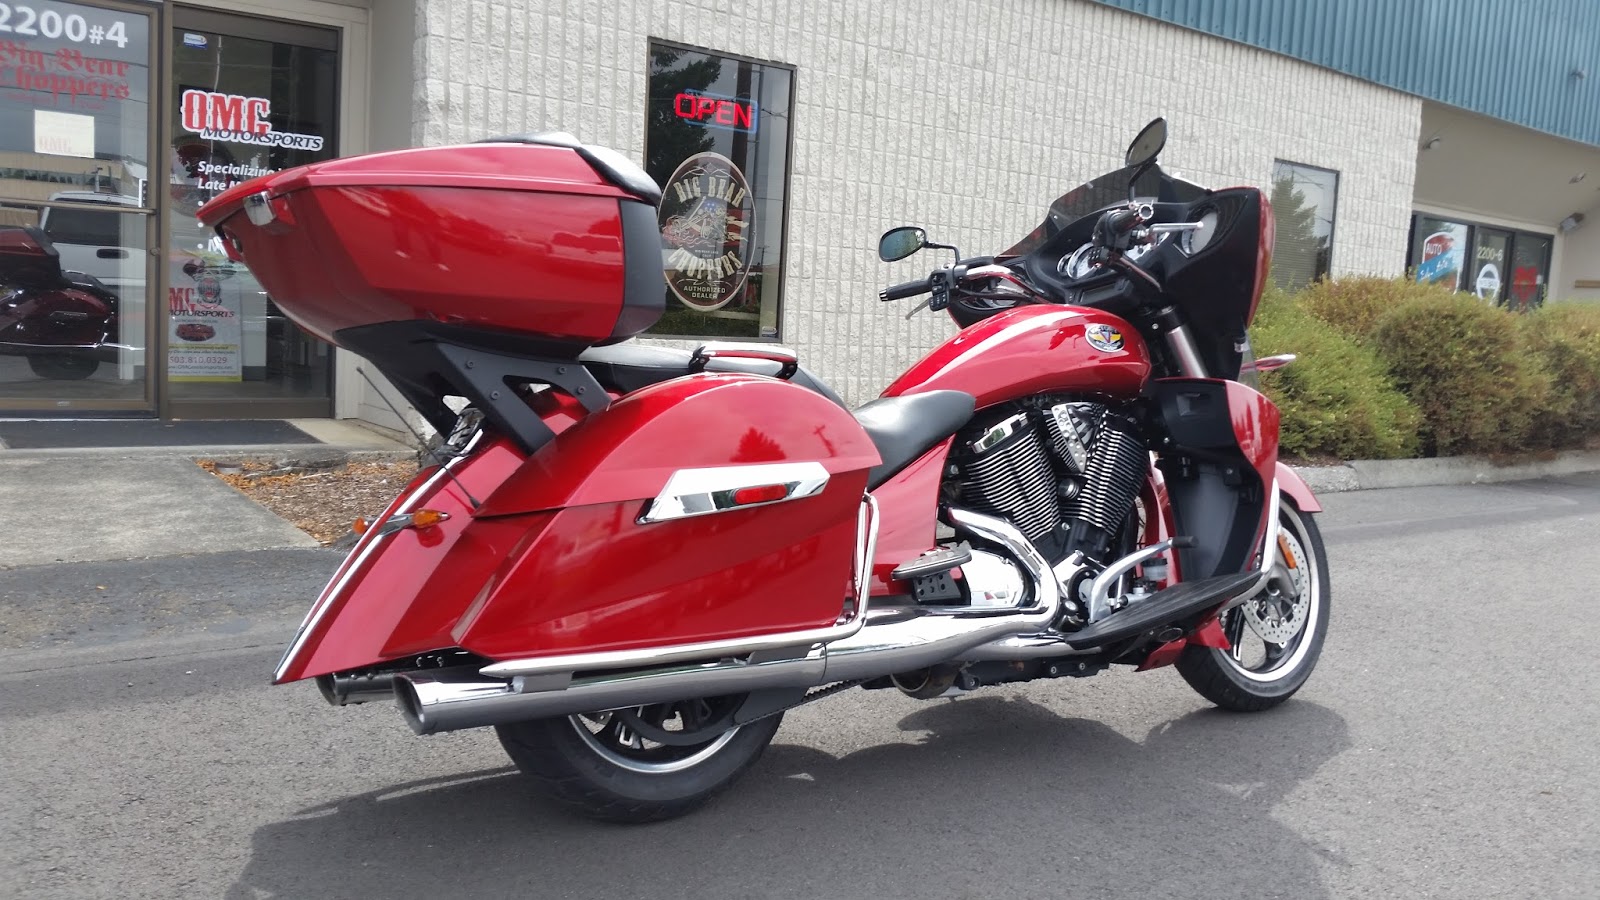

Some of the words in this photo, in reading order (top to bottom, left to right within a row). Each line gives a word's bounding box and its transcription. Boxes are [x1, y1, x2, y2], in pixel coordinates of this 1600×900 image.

[55, 47, 129, 77] Bear
[182, 90, 271, 137] OMG
[674, 93, 752, 128] OPEN
[202, 126, 322, 149] MOTORSPORTS
[197, 178, 227, 191] Late
[673, 176, 701, 203] BIG
[708, 176, 746, 208] BEAR
[1425, 243, 1442, 255] AUTO
[1477, 246, 1504, 262] 2200-6
[668, 247, 743, 280] CHOPPERS
[168, 287, 196, 313] MG
[683, 285, 726, 294] AUTHORIZED
[691, 292, 718, 300] DEALER
[169, 356, 228, 364] 503.810.0329
